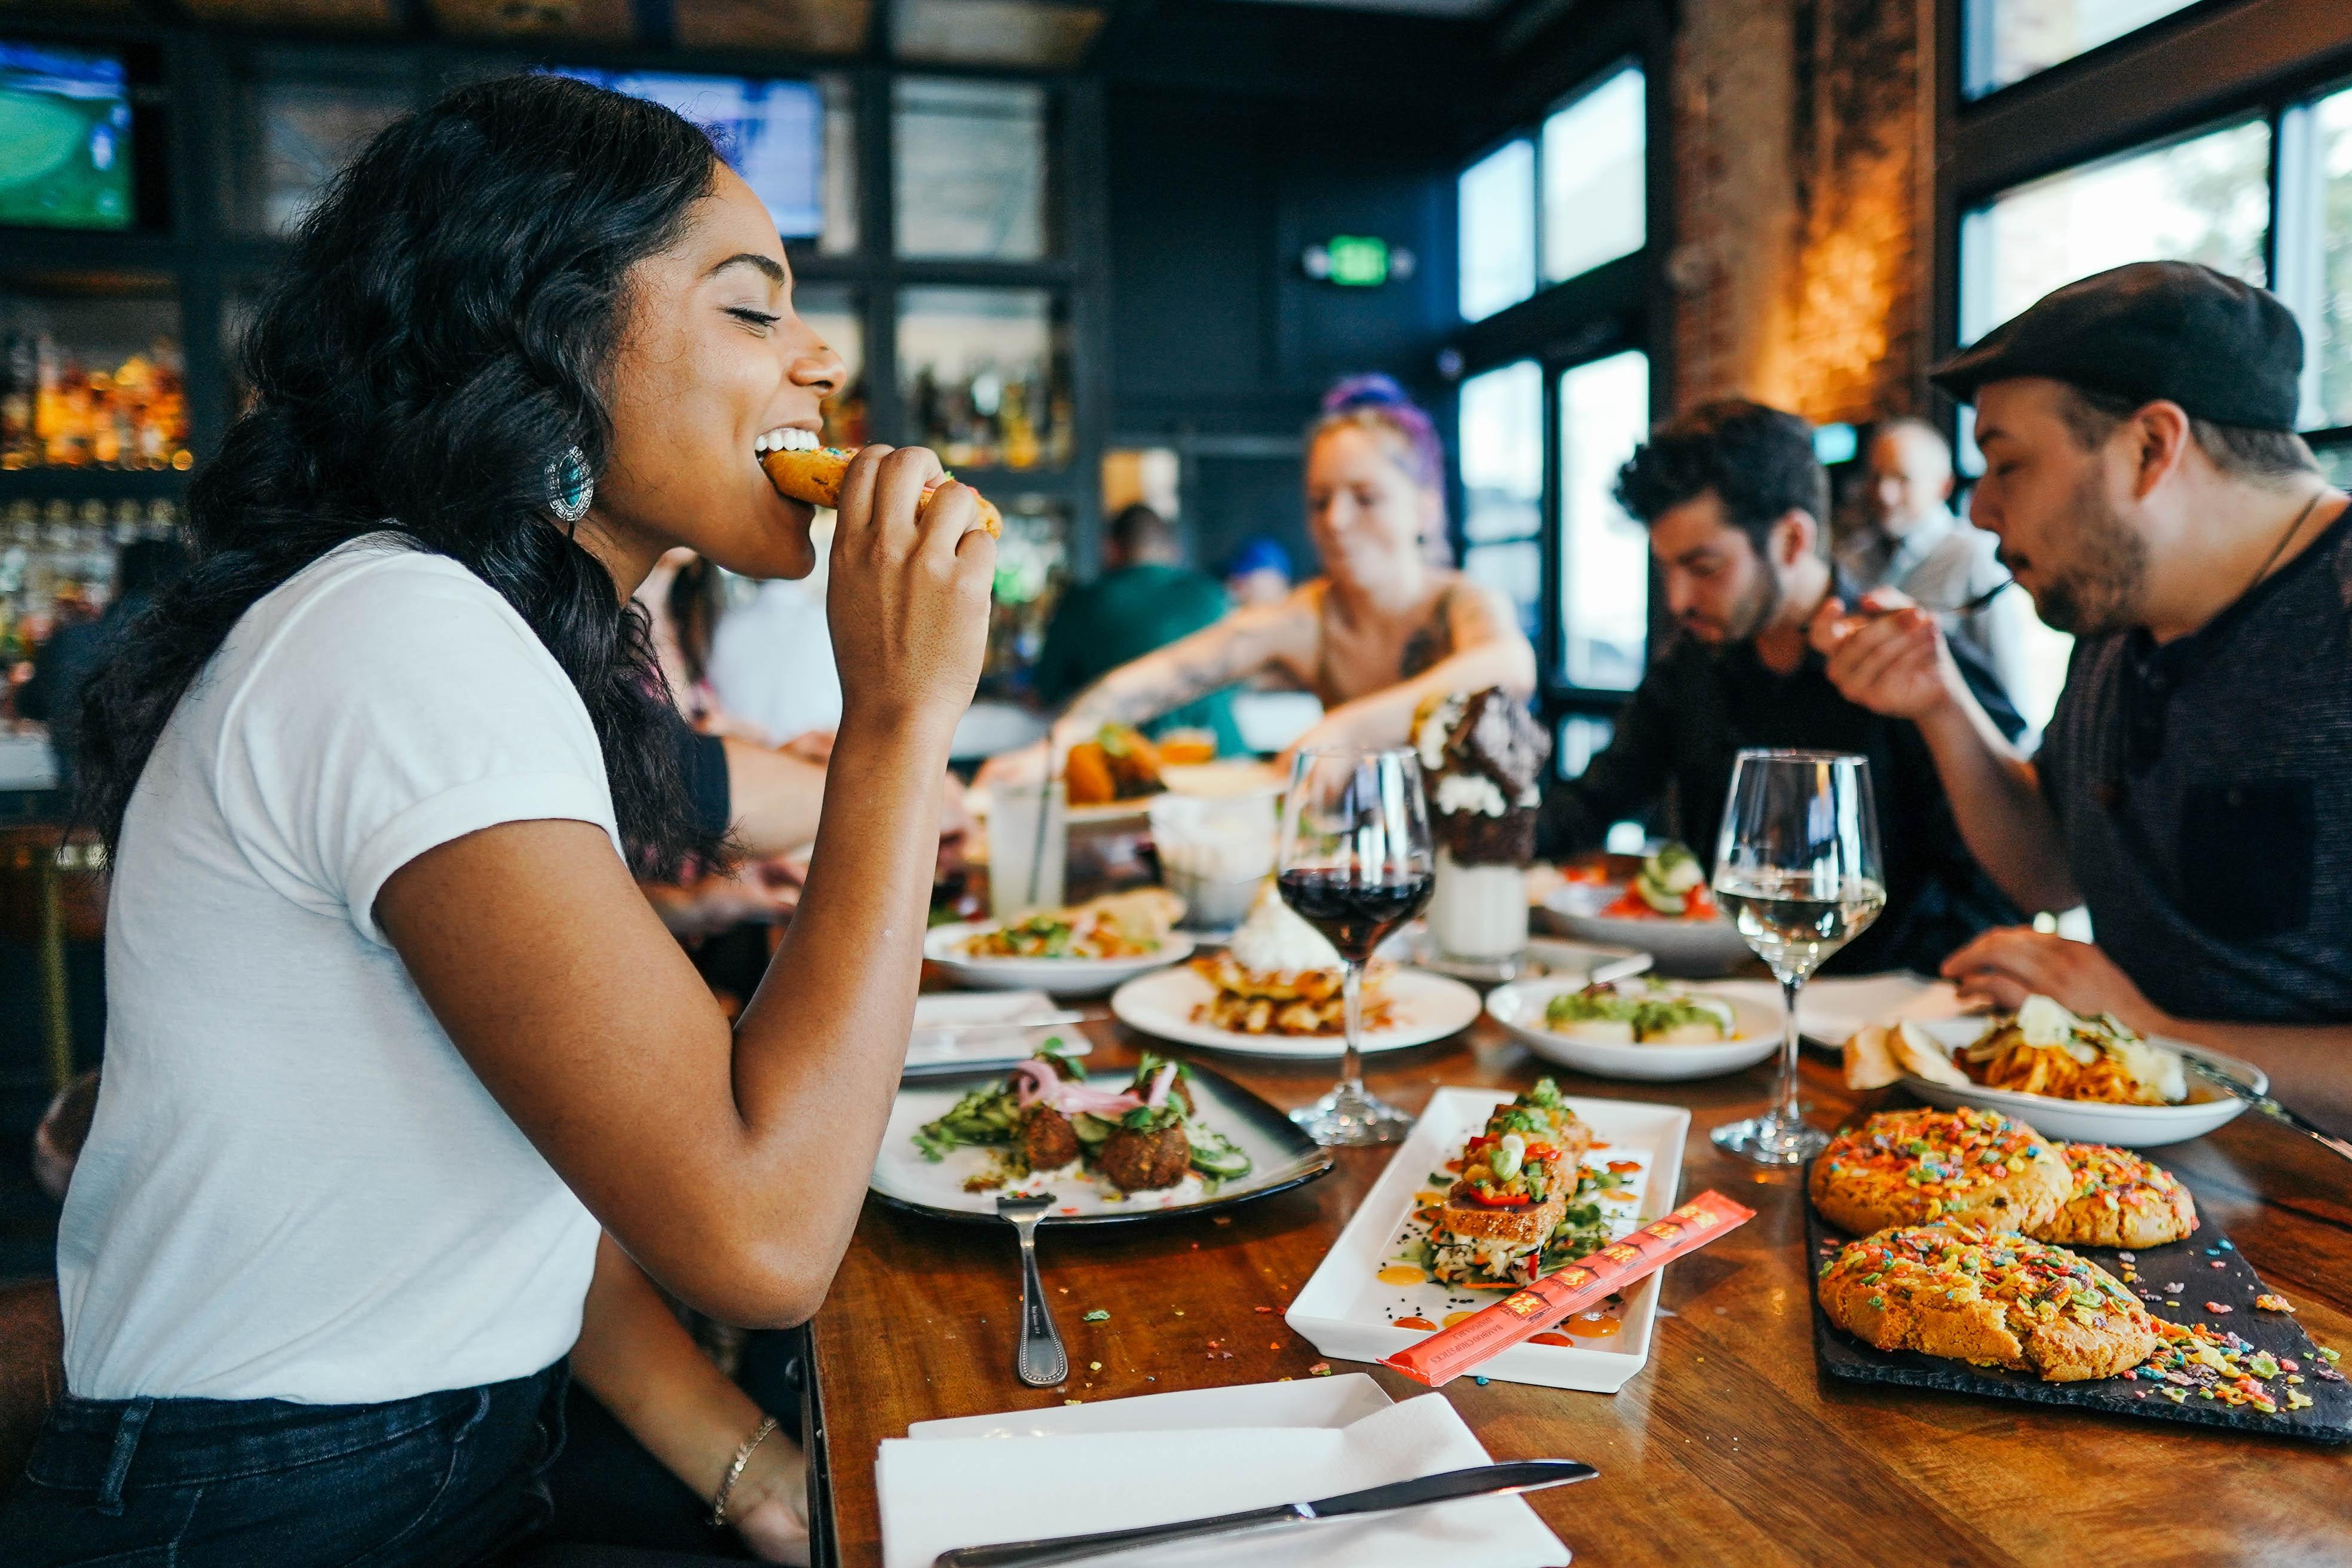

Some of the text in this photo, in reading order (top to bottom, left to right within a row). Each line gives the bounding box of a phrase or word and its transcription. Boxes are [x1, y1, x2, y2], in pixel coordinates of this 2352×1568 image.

[1450, 1317, 1493, 1340] DISPOSABLE
[1473, 1324, 1503, 1343] BAMBOO
[1430, 1339, 1474, 1364] CHOPSTICKS
